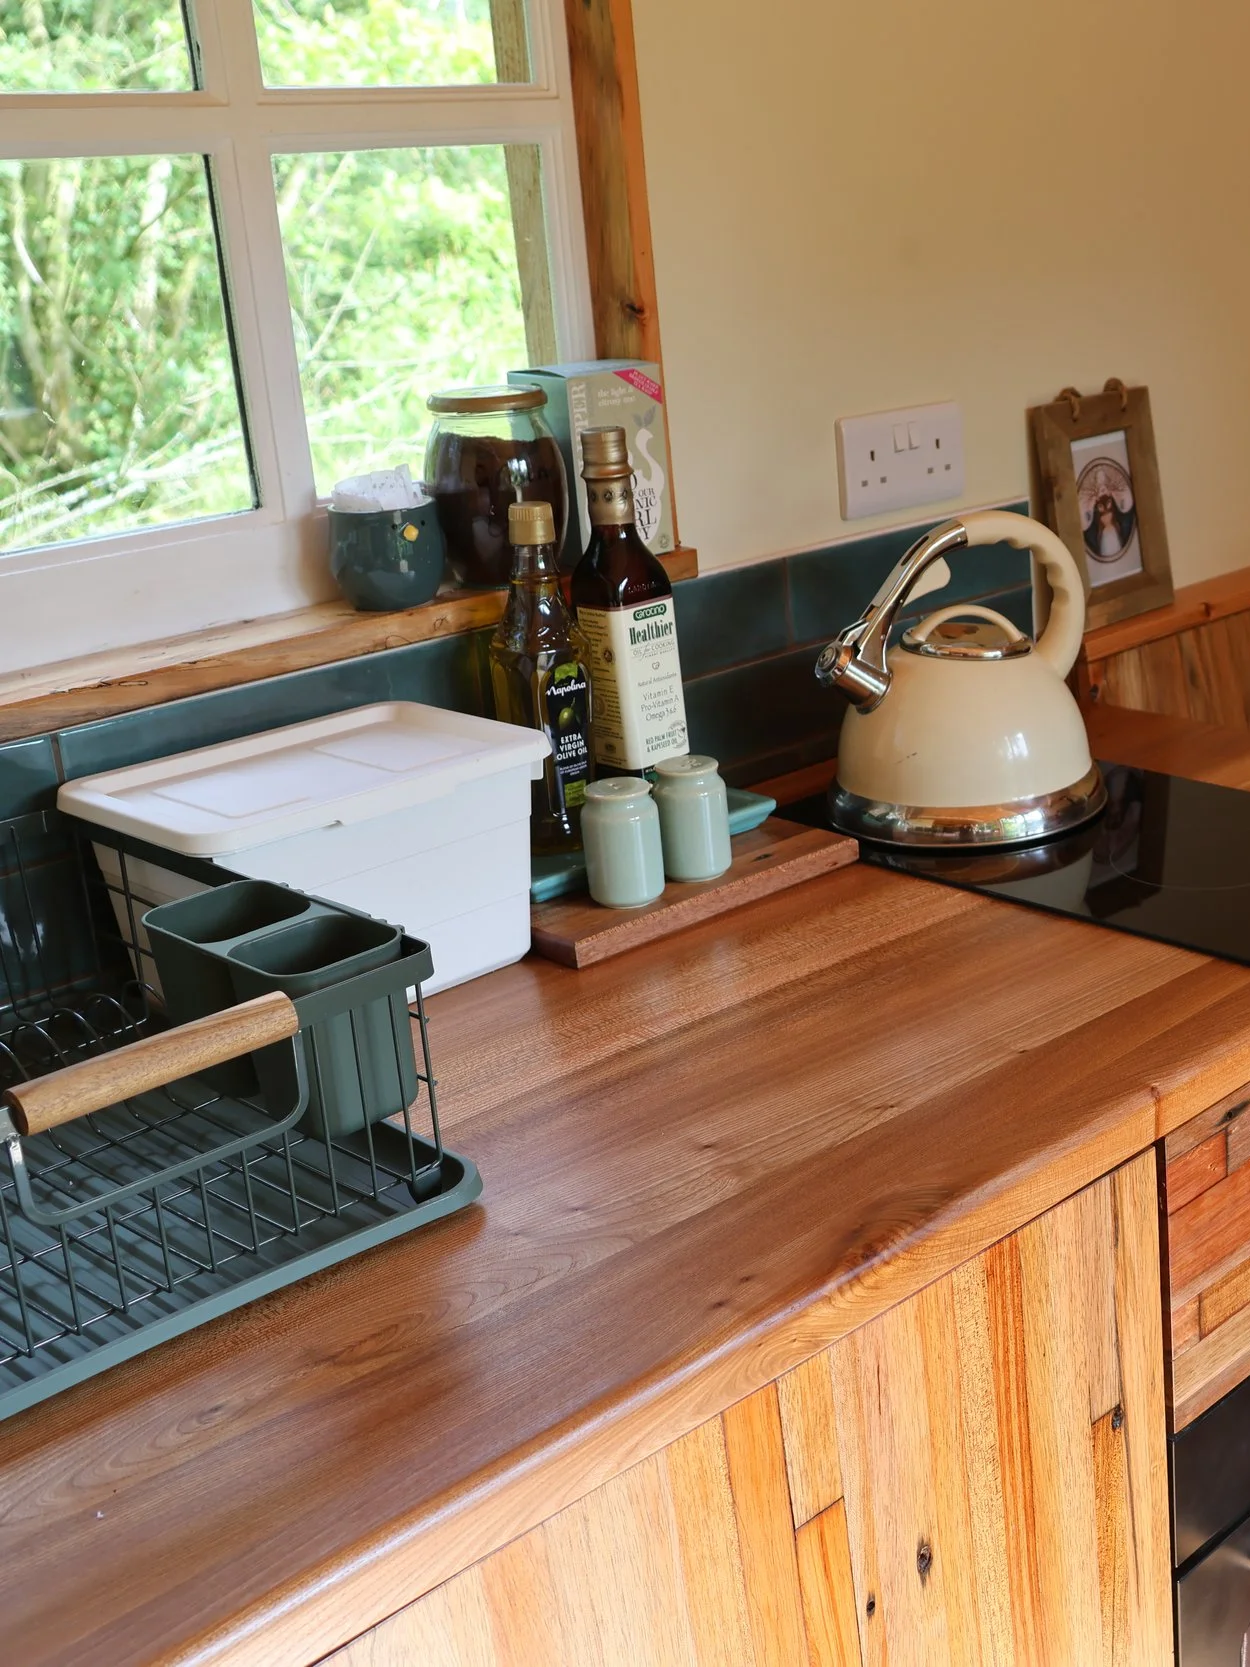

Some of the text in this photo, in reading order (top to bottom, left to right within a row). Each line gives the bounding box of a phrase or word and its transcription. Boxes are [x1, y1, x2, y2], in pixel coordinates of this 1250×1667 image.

[629, 620, 673, 646] Healthier
[545, 680, 586, 697] Napolina
[643, 685, 675, 701] Vitamin E
[646, 711, 667, 721] Omega
[561, 733, 582, 745] EXTRA
[560, 740, 585, 753] VIRGIN
[557, 747, 589, 761] OLIVE OIL
